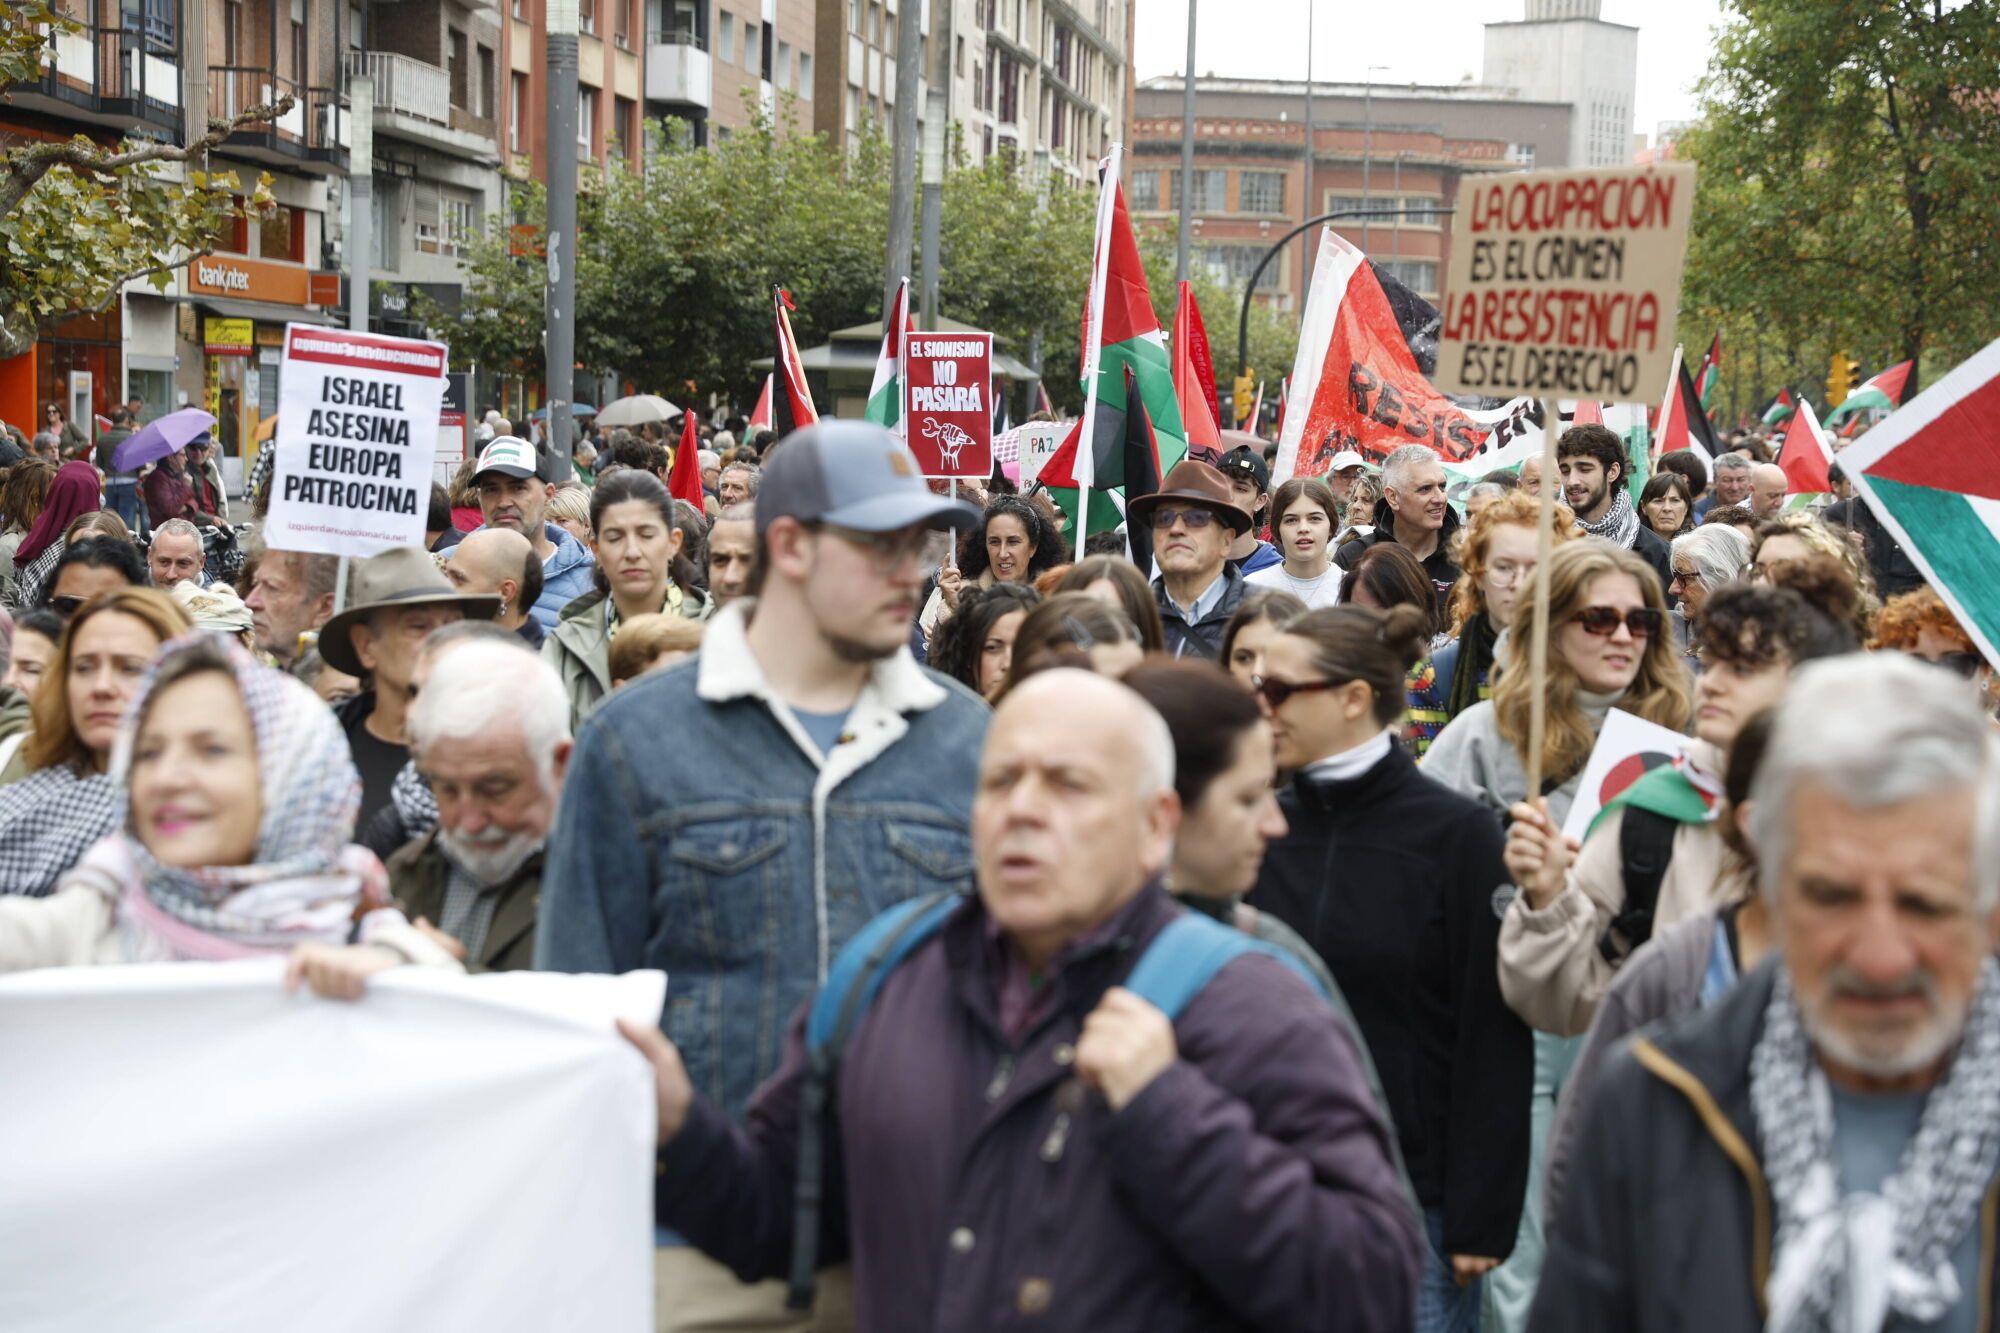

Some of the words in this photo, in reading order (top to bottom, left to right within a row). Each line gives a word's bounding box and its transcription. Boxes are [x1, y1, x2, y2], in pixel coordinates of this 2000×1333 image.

[1471, 186, 1504, 232] LA
[1507, 168, 1676, 232] OCUPACIÓN
[1470, 238, 1497, 282] ES
[1503, 238, 1530, 281] EL
[1533, 235, 1625, 282] CRIMEN
[1444, 291, 1478, 342] LA
[1480, 288, 1660, 352] RESISTENCIA
[356, 344, 441, 368] REVOLUCIONARIA
[911, 341, 923, 357] EL
[924, 341, 985, 358] SIONISMO
[932, 360, 957, 386] NO
[1459, 343, 1488, 386] ES
[1490, 345, 1518, 388] EL
[1521, 347, 1640, 397] DERECHO
[321, 376, 404, 411] ISRAEL
[911, 382, 983, 412] PASARÁ
[307, 409, 411, 446] ASESINA
[308, 443, 402, 479] EUROPA
[284, 475, 417, 515] PATROCINA
